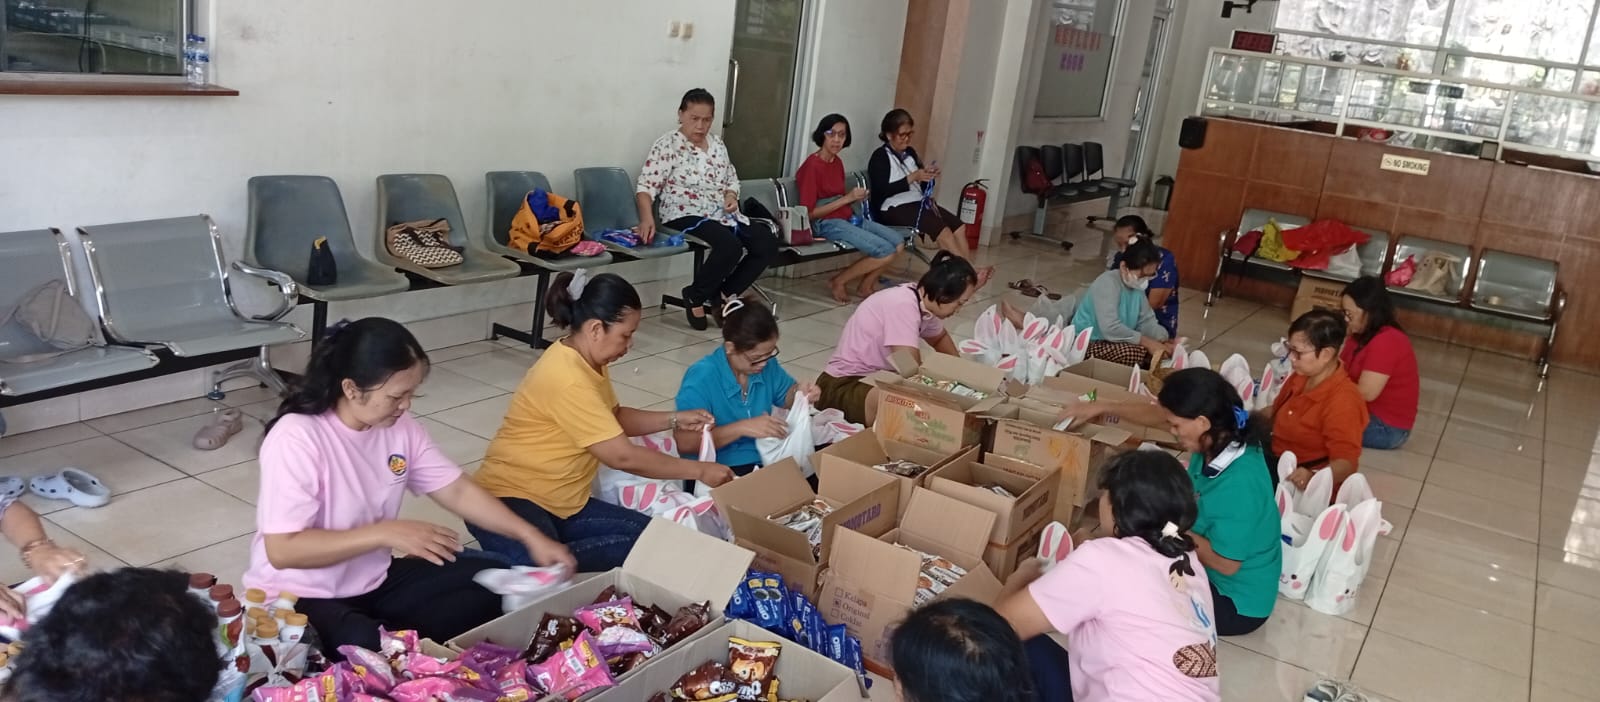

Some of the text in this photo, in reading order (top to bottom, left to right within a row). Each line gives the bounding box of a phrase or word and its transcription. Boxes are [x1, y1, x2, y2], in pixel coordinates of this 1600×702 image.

[1393, 159, 1428, 172] NO SMOKING
[842, 602, 871, 620] Original
